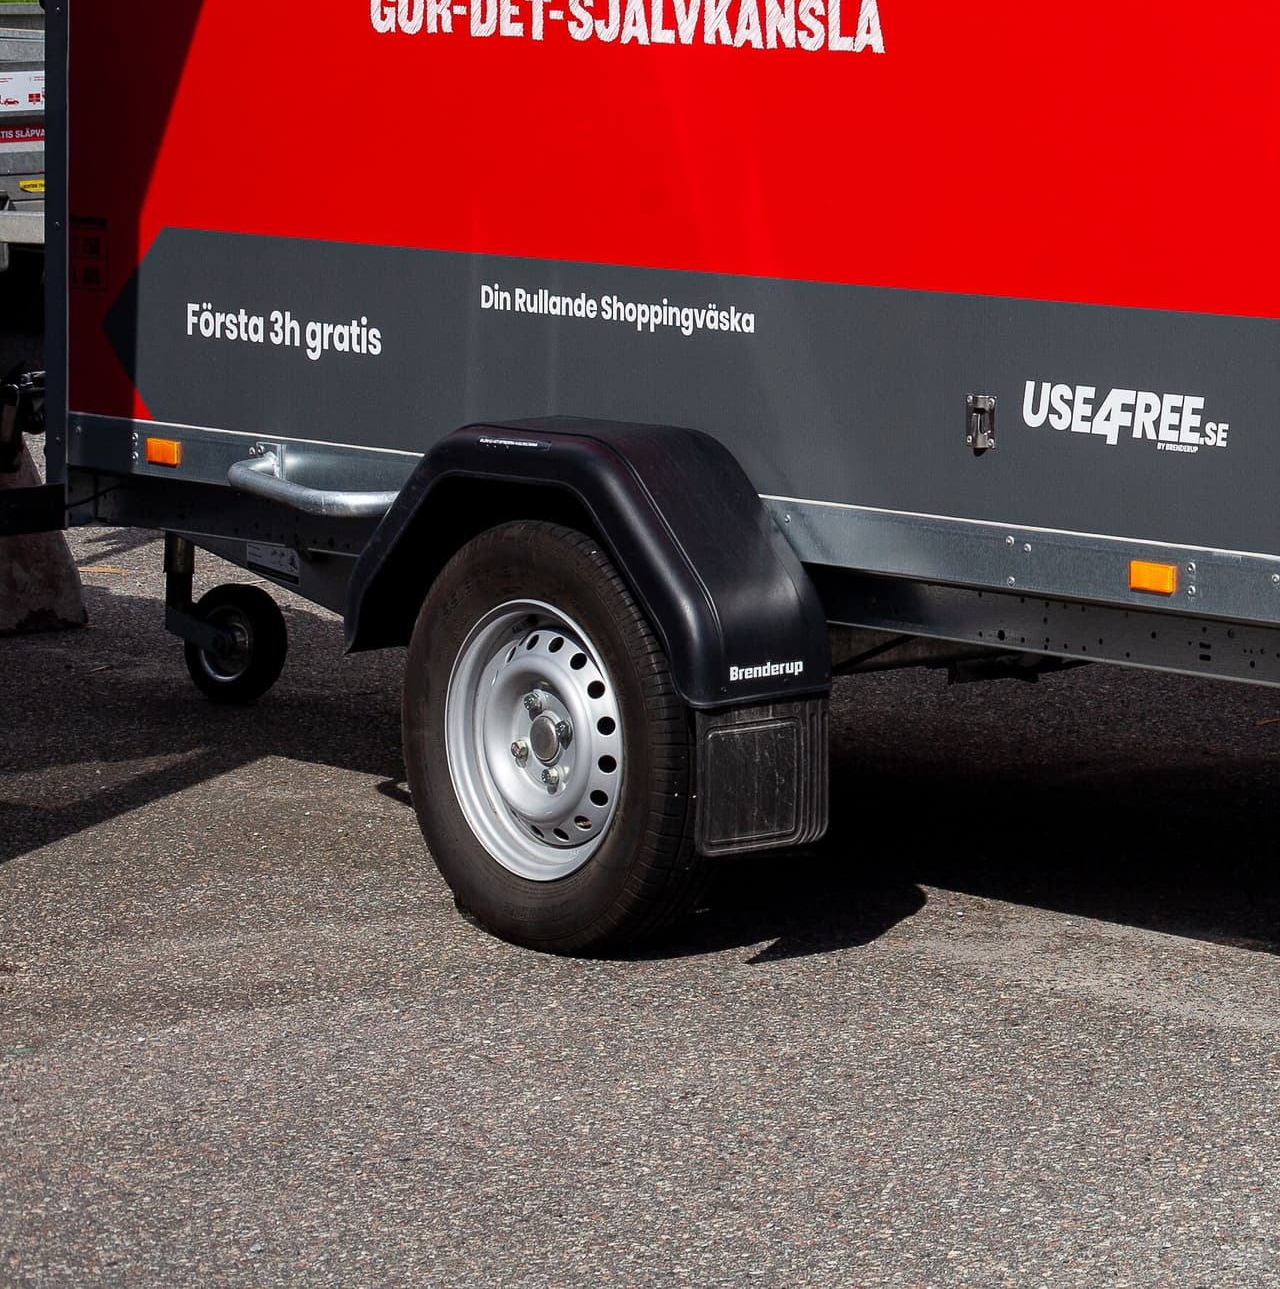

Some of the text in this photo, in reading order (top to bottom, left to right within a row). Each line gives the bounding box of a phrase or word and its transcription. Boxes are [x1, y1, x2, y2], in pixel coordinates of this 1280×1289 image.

[187, 302, 382, 361] Första 3h gratis
[480, 283, 755, 336] Din Rullande Shoppingväska
[729, 661, 804, 681] Brenderup
